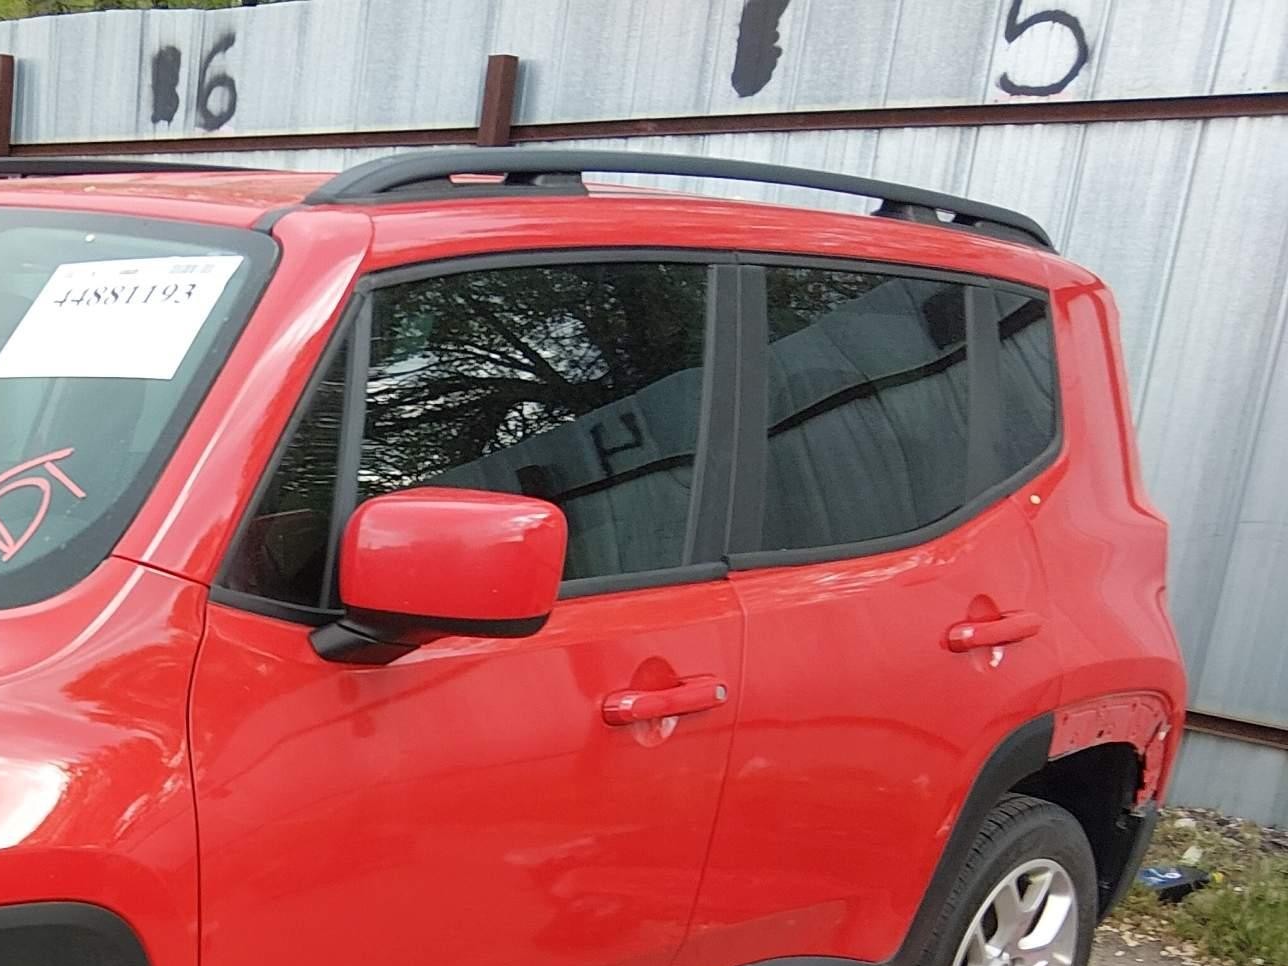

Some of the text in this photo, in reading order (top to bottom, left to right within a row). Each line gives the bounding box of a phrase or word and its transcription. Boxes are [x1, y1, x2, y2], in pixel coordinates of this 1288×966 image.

[196, 32, 237, 132] 6
[998, 0, 1089, 96] 5
[53, 283, 197, 307] 44881193
